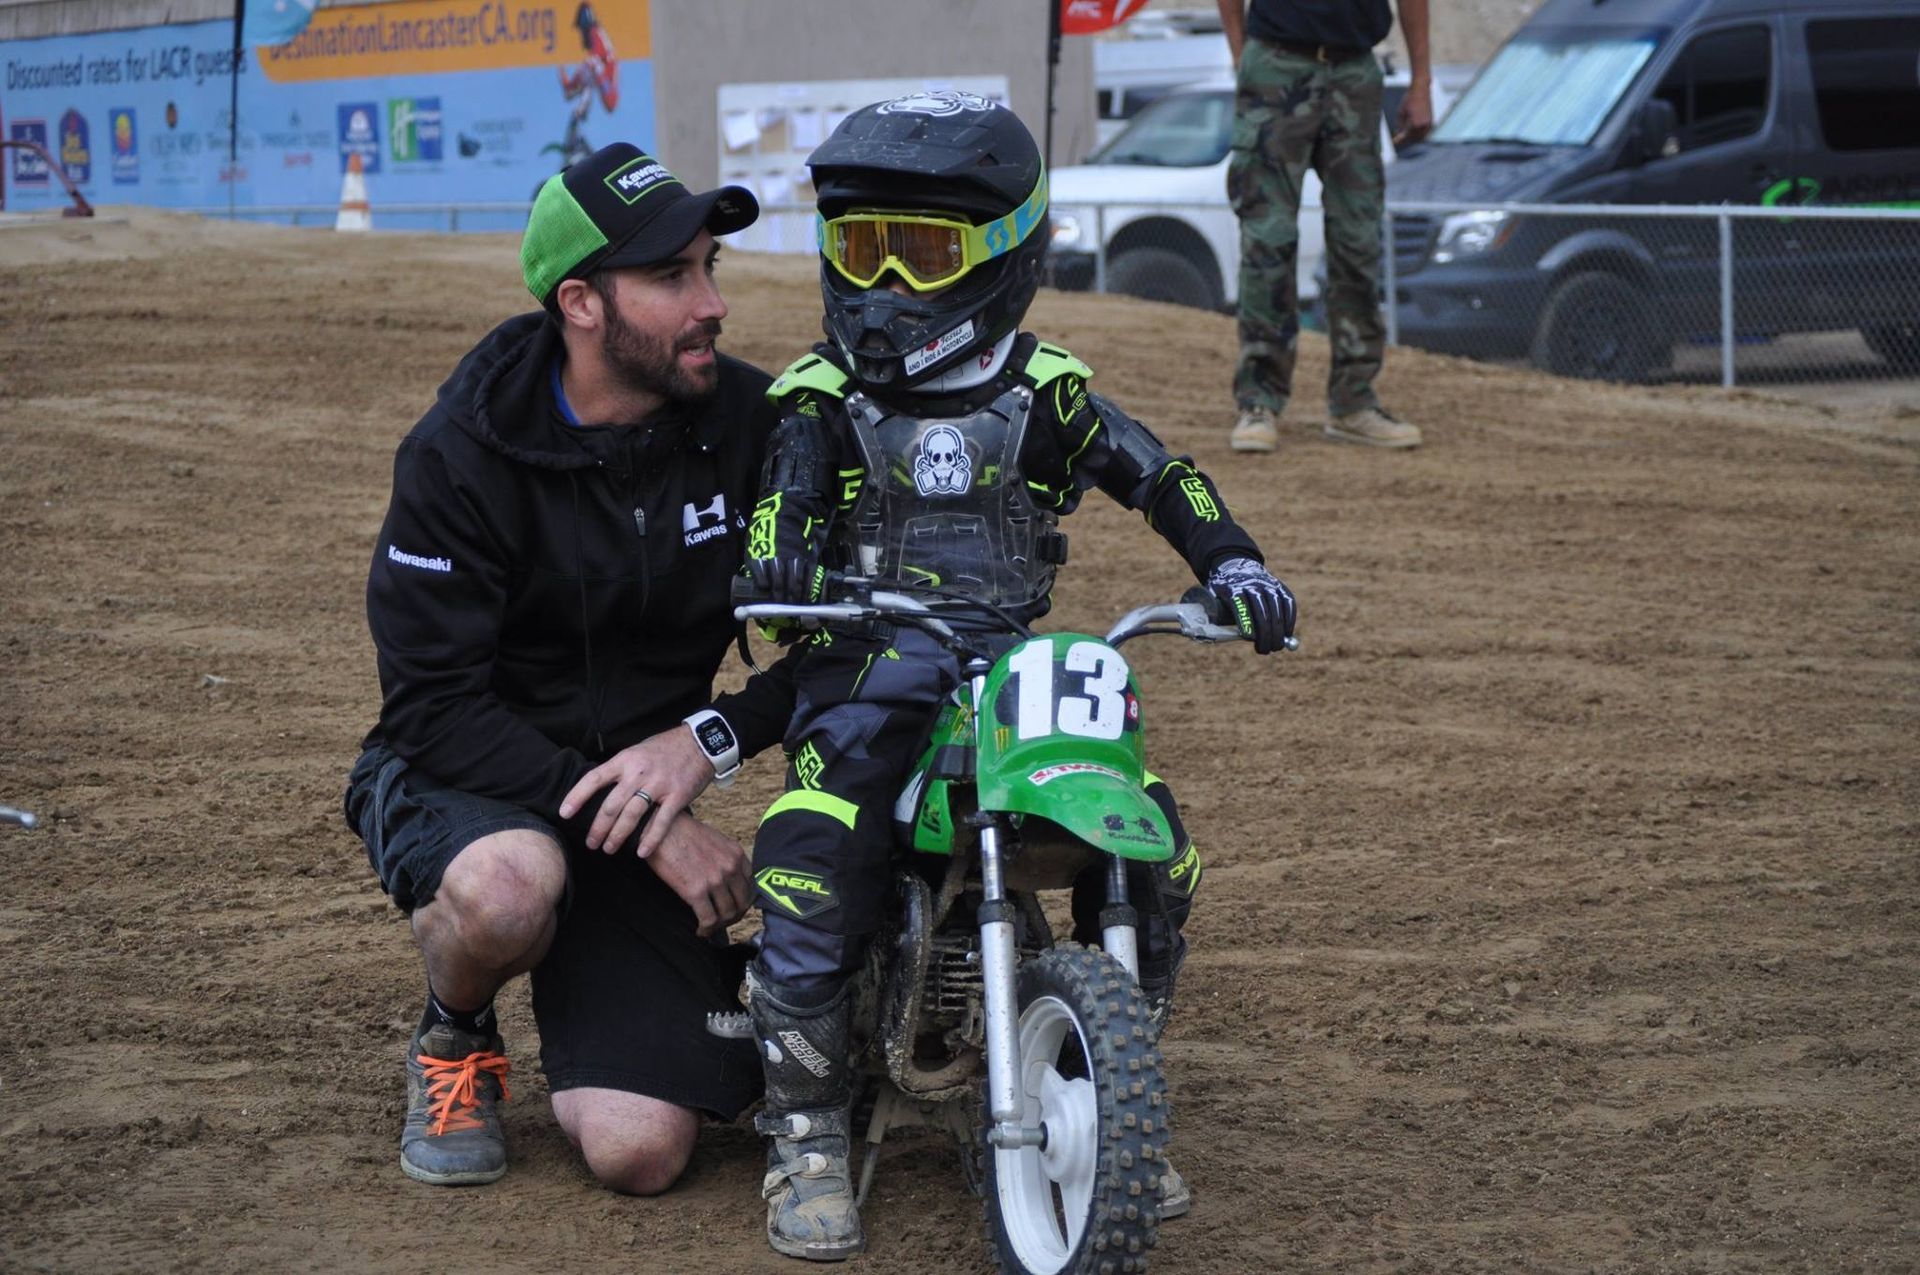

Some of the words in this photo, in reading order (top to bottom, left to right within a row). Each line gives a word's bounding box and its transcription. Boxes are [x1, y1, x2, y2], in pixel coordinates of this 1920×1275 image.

[7, 53, 83, 90] Discounted
[87, 56, 121, 84] rates
[125, 48, 147, 83] for
[151, 46, 191, 80] LACR
[908, 360, 921, 374] AND
[388, 544, 452, 572] Kawasaki
[1009, 639, 1129, 740] 13
[770, 873, 830, 896] ONEAL
[784, 1040, 830, 1078] RACING
[786, 1030, 831, 1068] MOOSE
